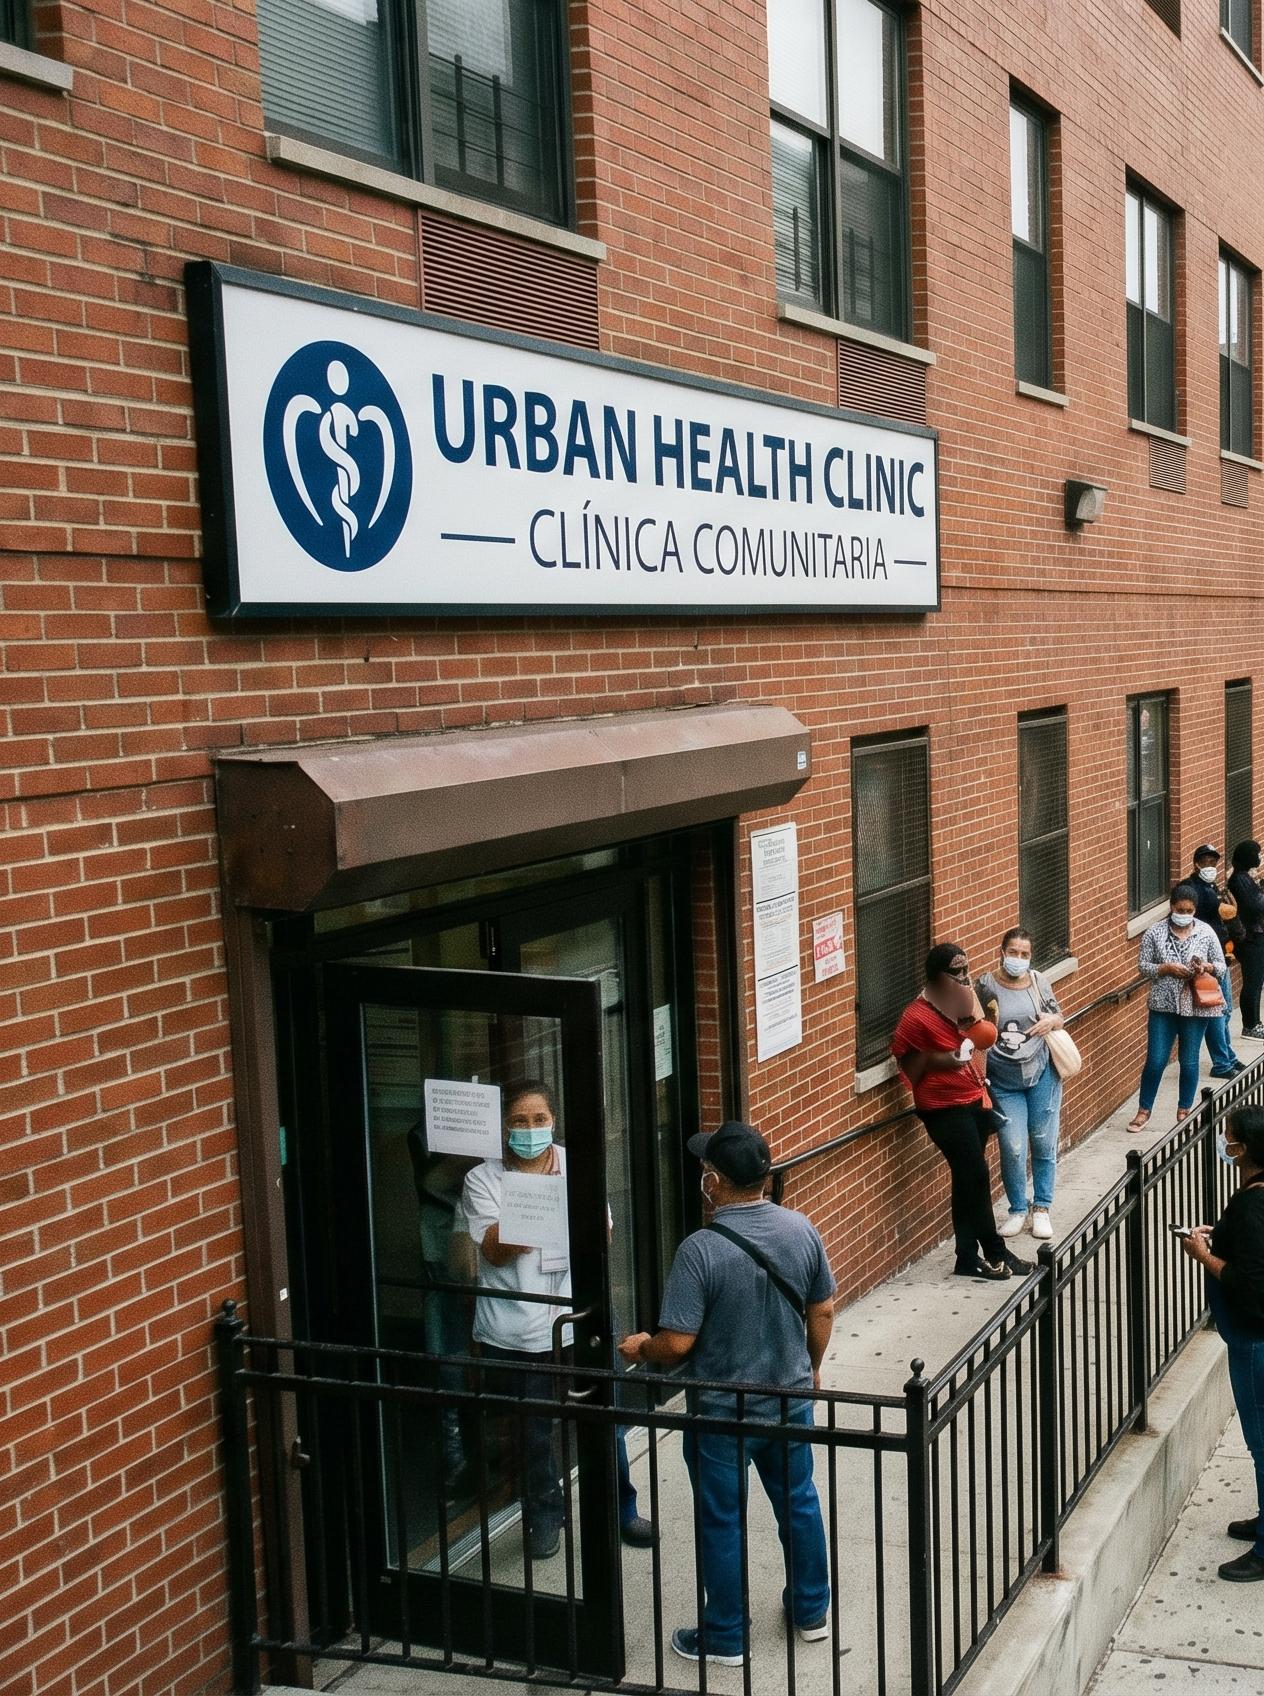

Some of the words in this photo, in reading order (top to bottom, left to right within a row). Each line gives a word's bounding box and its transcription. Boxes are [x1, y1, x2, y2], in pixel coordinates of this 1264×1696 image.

[432, 374, 638, 484] URBAN
[654, 415, 813, 505] HEALTH
[824, 446, 925, 518] CLINIC
[529, 500, 684, 575] CLÍNICA
[693, 522, 888, 581] COMUNITARIA
